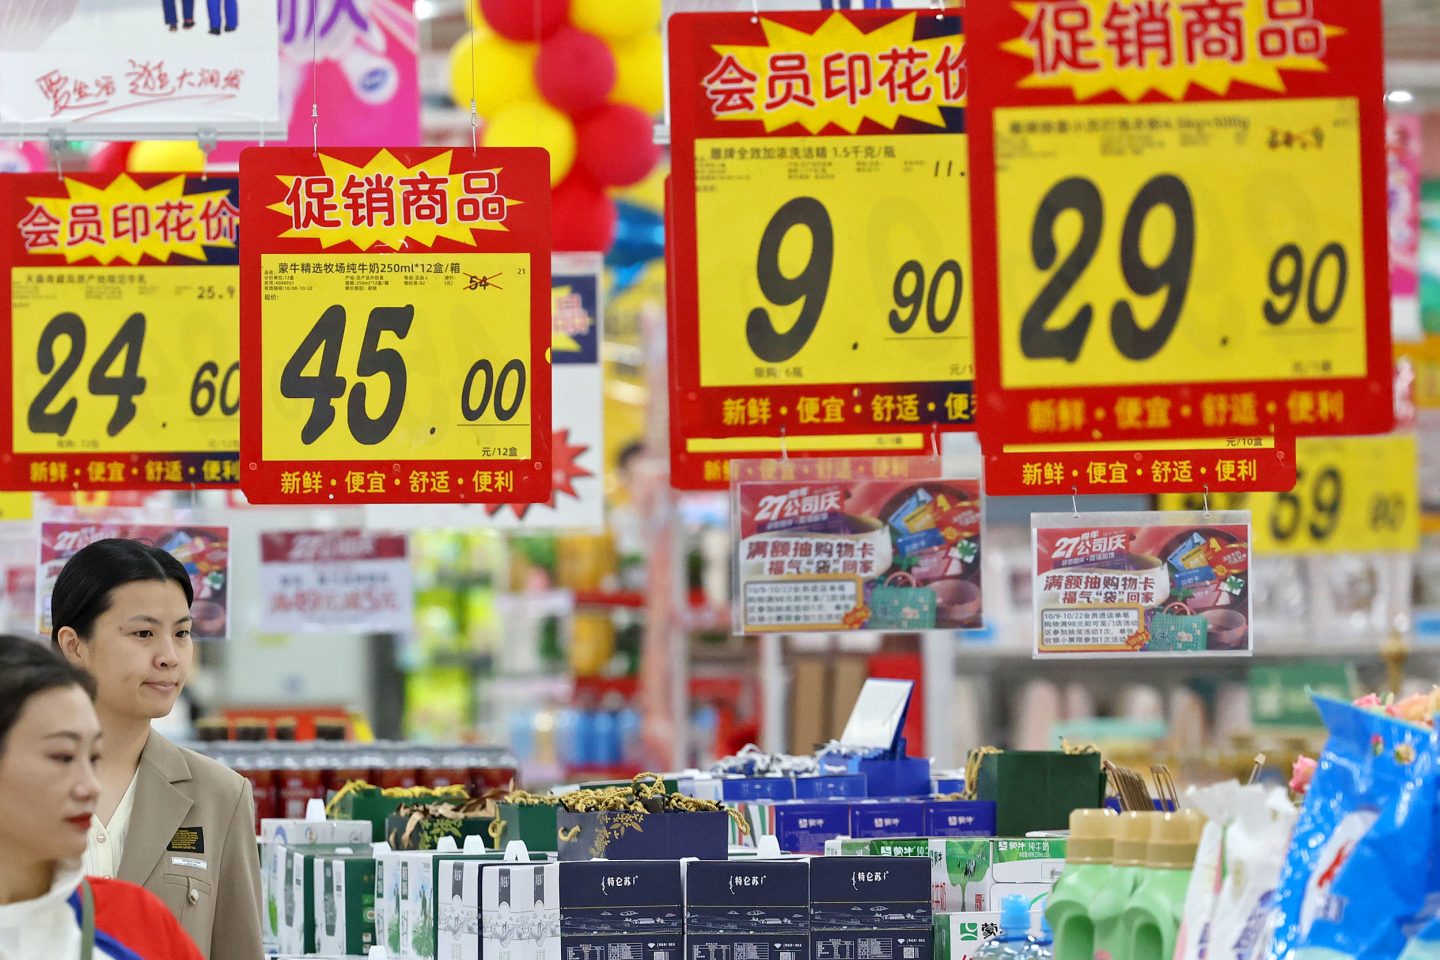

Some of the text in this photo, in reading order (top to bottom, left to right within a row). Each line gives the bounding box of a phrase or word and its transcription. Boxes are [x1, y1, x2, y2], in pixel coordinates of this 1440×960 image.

[1023, 0, 1328, 75] 促销商品
[284, 170, 507, 229] 促销商品
[18, 200, 240, 249] 会员印花价
[481, 447, 518, 457] 元/12盒
[746, 541, 876, 560] 满额抽购物卡
[1051, 534, 1126, 560] 27公司庆
[1043, 575, 1156, 592] 满额抽购物卡
[1062, 590, 1155, 605] 福气“袋”回家
[607, 876, 632, 888] 特仑苏
[734, 875, 759, 887] 特仑苏
[858, 871, 882, 883] 特仑苏
